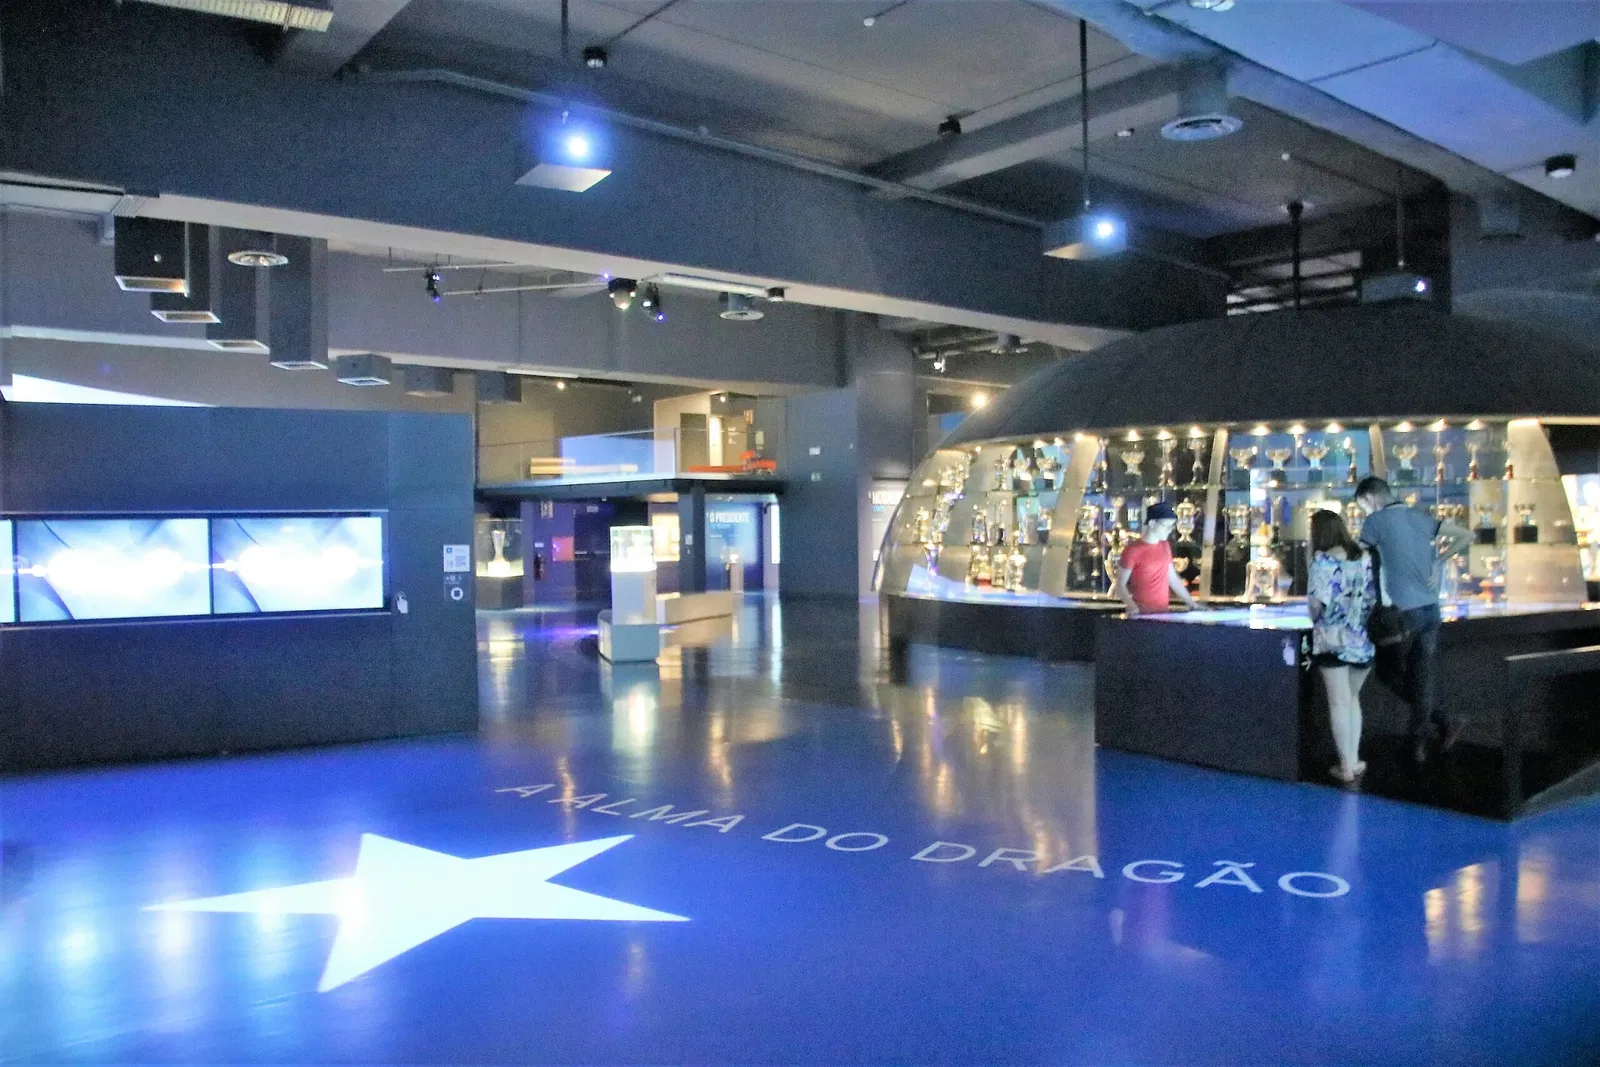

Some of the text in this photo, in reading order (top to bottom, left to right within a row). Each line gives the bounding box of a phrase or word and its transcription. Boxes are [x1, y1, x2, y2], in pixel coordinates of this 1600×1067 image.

[494, 783, 1350, 898] A ALMA DO DRAGÃO
